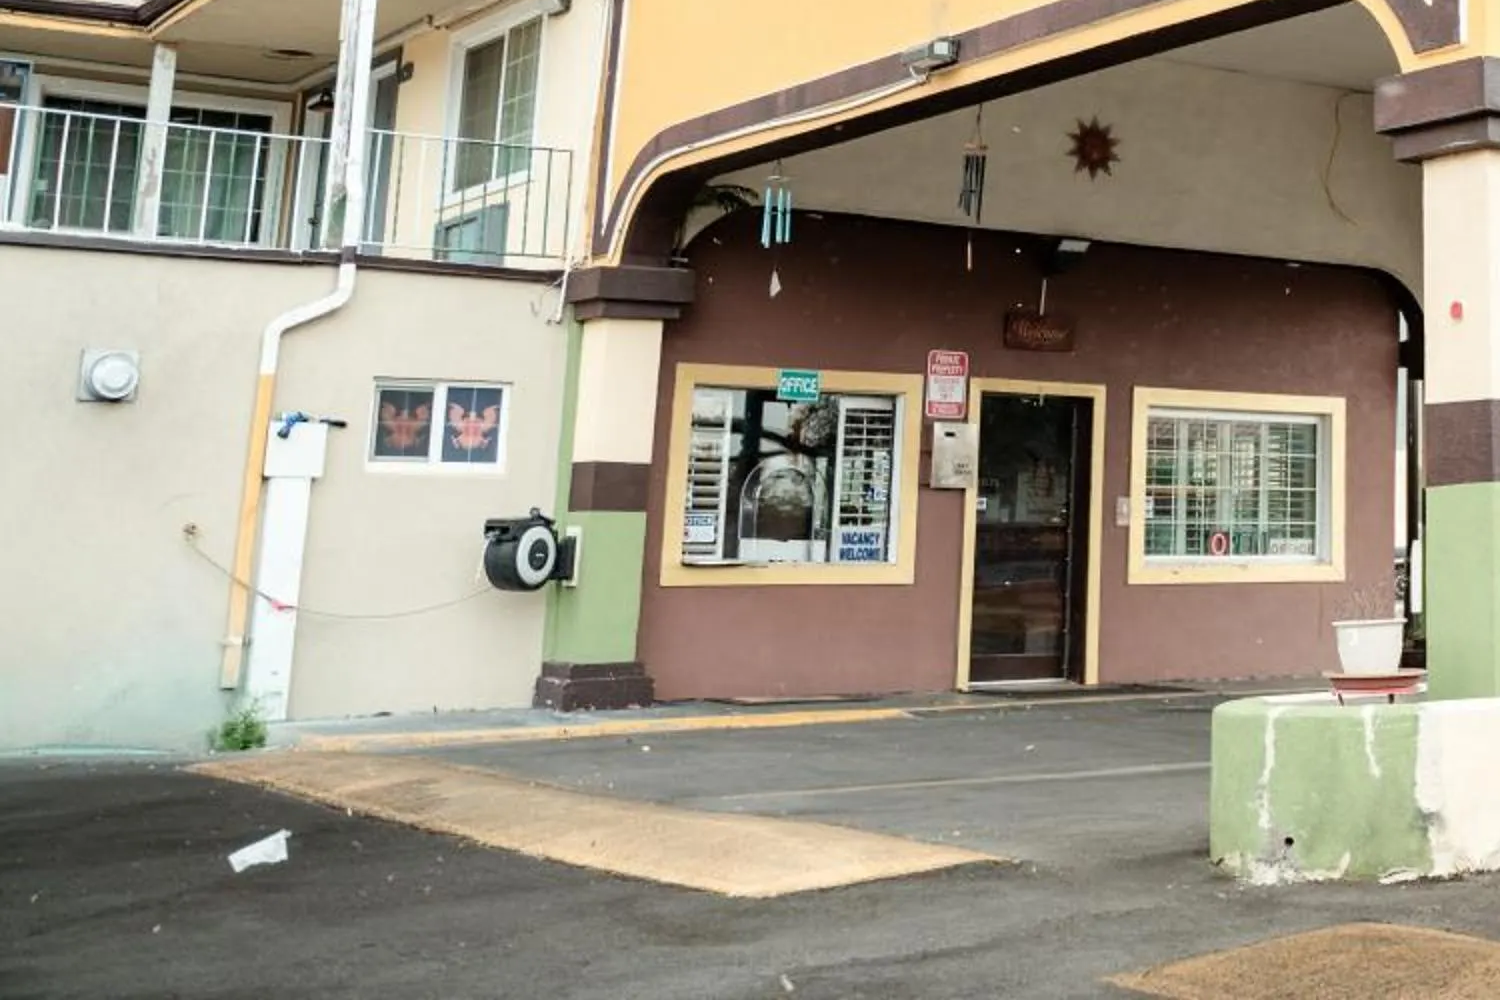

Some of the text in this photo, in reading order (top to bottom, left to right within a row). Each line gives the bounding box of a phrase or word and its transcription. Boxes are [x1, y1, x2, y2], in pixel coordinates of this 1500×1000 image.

[781, 376, 817, 393] OFFICE
[841, 531, 880, 545] VACANCY
[839, 547, 881, 561] WELCOME
